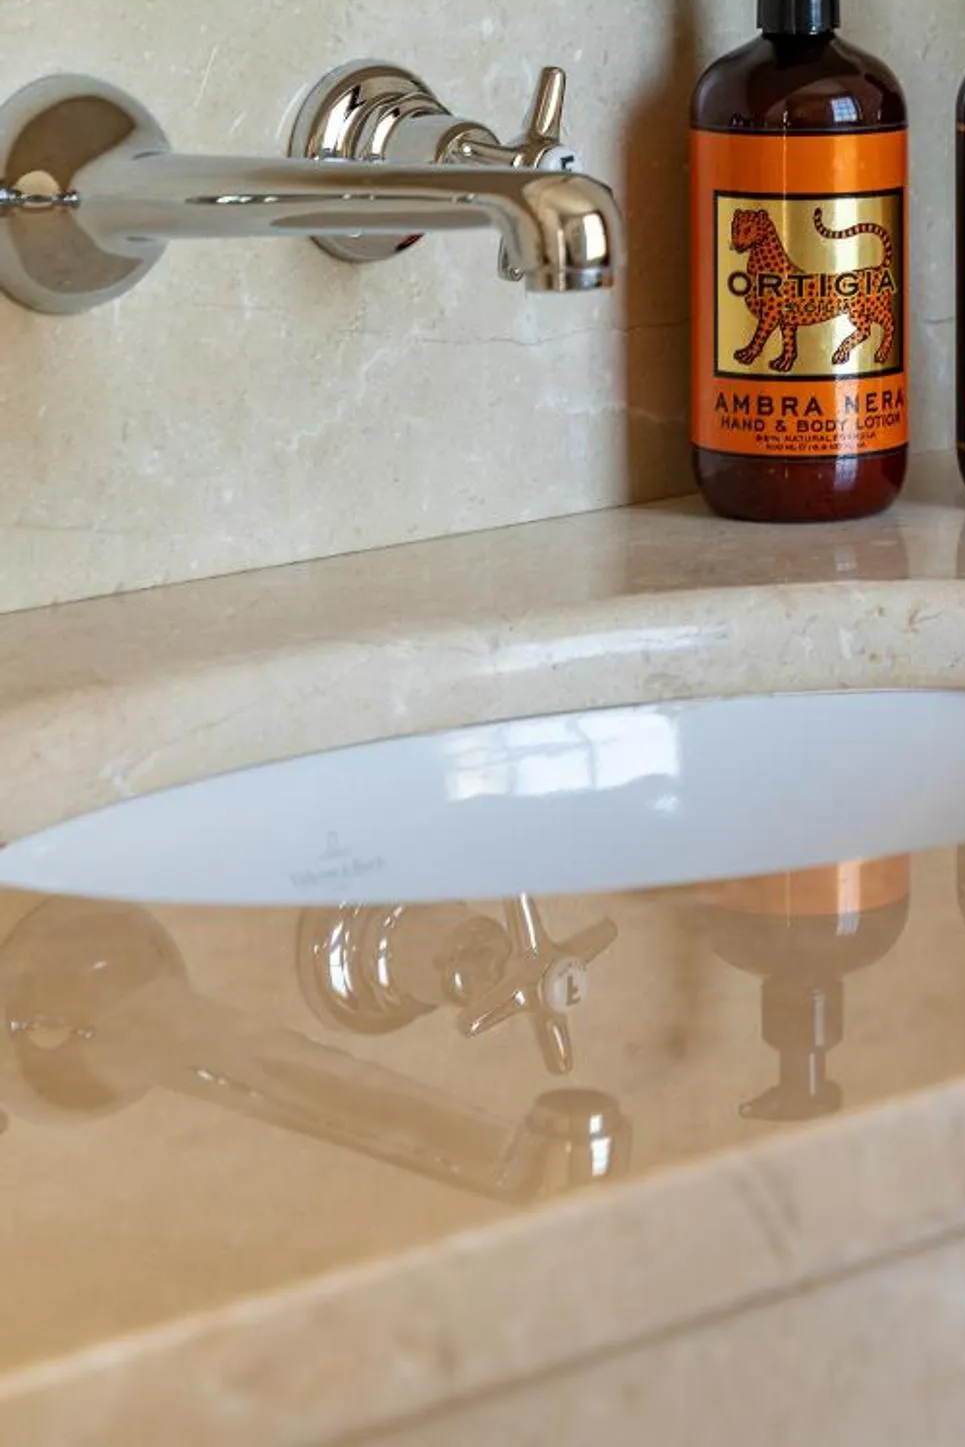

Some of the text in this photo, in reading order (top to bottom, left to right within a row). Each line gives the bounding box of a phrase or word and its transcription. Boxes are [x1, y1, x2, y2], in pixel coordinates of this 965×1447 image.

[728, 269, 896, 297] ORTIGIA
[715, 388, 905, 417] AMBRA NERA
[721, 412, 901, 433] HAND & BODY LOTION
